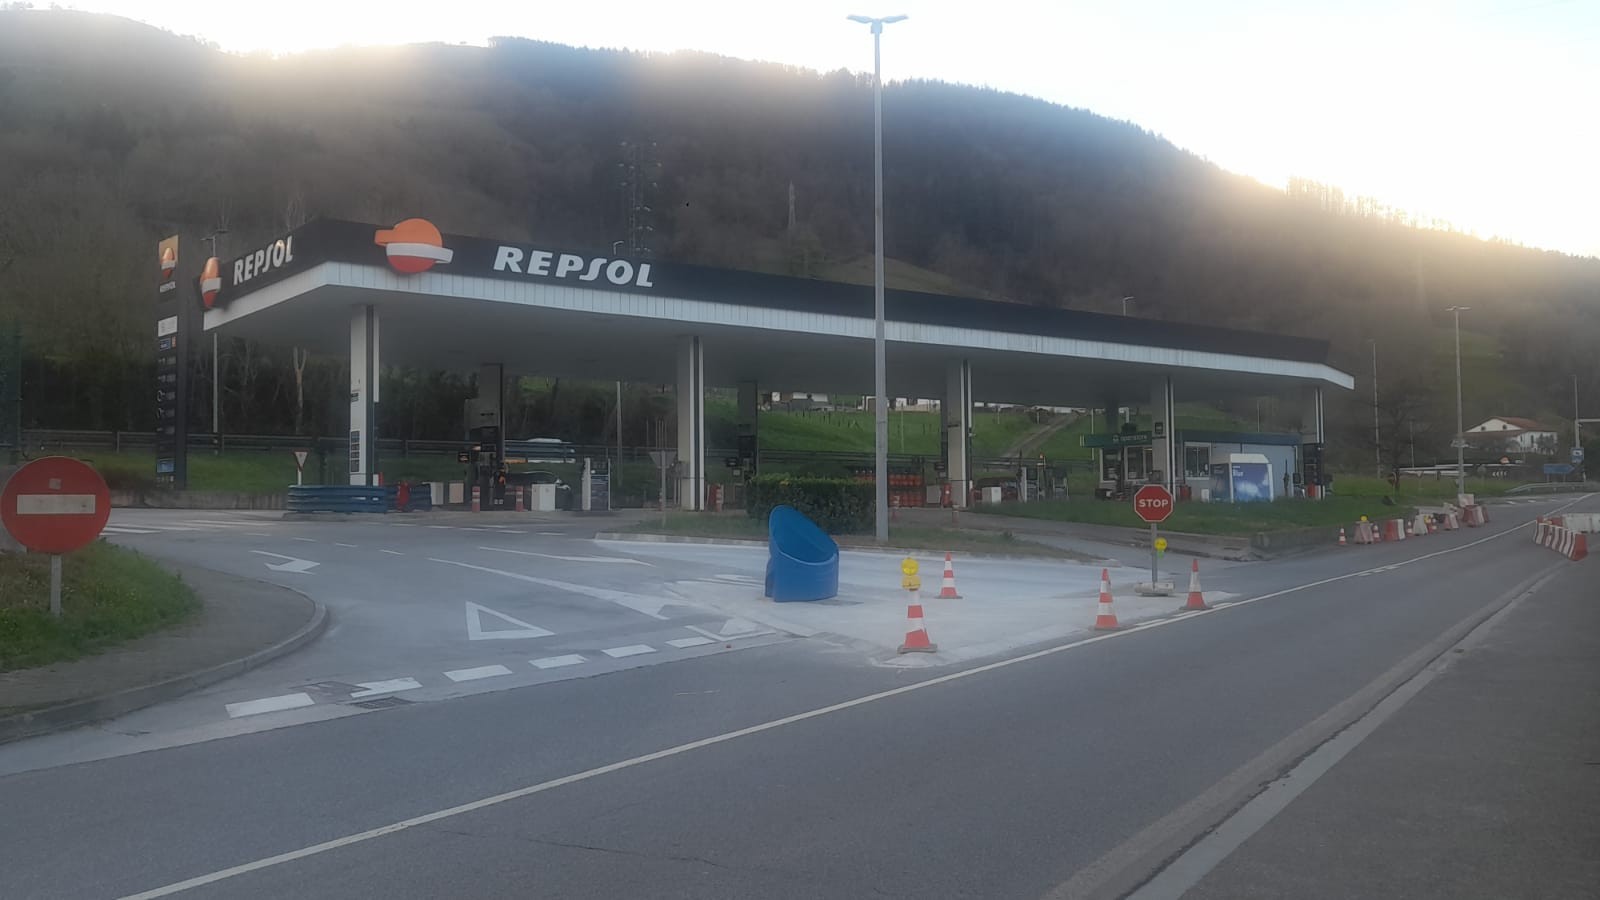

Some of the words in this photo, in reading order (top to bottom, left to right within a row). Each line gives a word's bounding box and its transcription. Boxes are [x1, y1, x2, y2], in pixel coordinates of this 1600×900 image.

[233, 235, 294, 286] REPSOL
[493, 245, 653, 288] REPSOL
[1138, 498, 1169, 509] STOP
